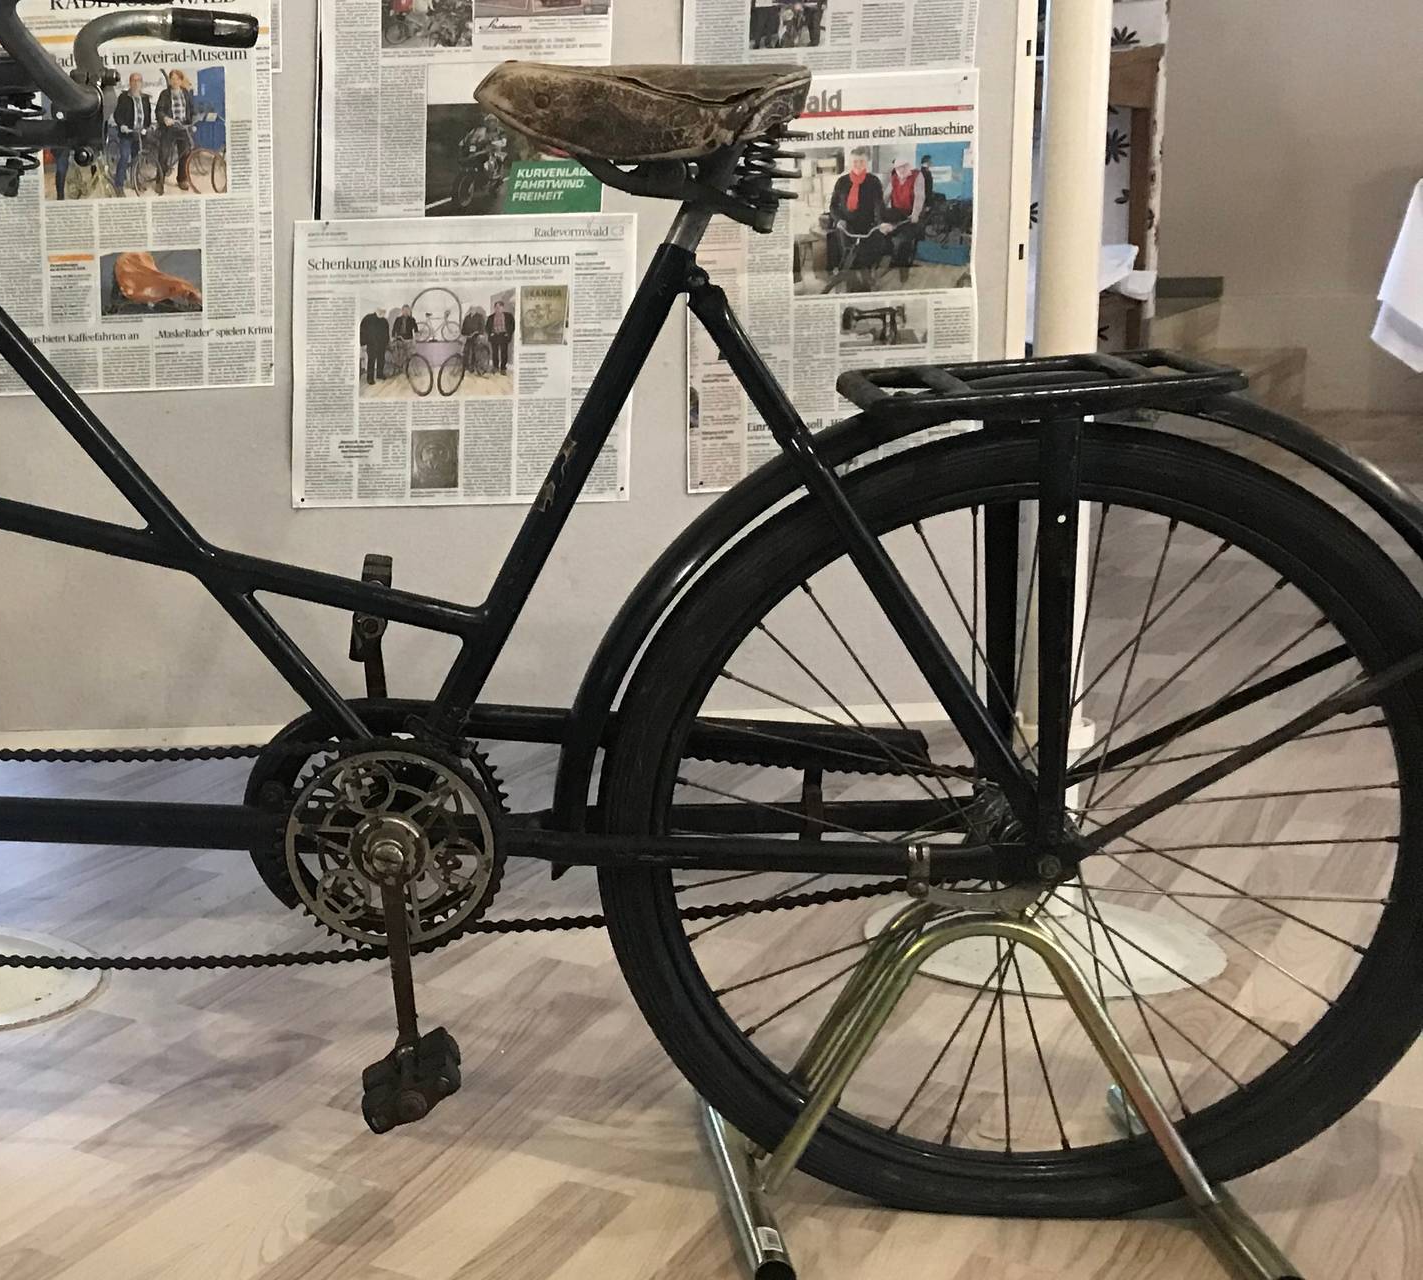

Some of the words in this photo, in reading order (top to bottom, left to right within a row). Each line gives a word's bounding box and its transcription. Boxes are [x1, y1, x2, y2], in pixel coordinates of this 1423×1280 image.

[112, 52, 130, 65] im
[133, 49, 248, 65] Zweirad-Museum
[816, 127, 844, 140] steht
[848, 128, 870, 139] nun
[872, 126, 896, 138] eine
[898, 122, 974, 137] Nähmaschine
[514, 179, 586, 190] FAHRTWIND.
[534, 226, 609, 238] Radevormwald
[307, 257, 377, 272] Schenkung
[379, 258, 401, 269] aus
[403, 255, 433, 268] Köln
[435, 255, 459, 268] fürs
[461, 253, 570, 267] Zweirad-Museum
[68, 332, 126, 343] Kaffeefahrten
[128, 333, 139, 341] an
[216, 326, 246, 338] spielen
[248, 325, 273, 336] Krimi
